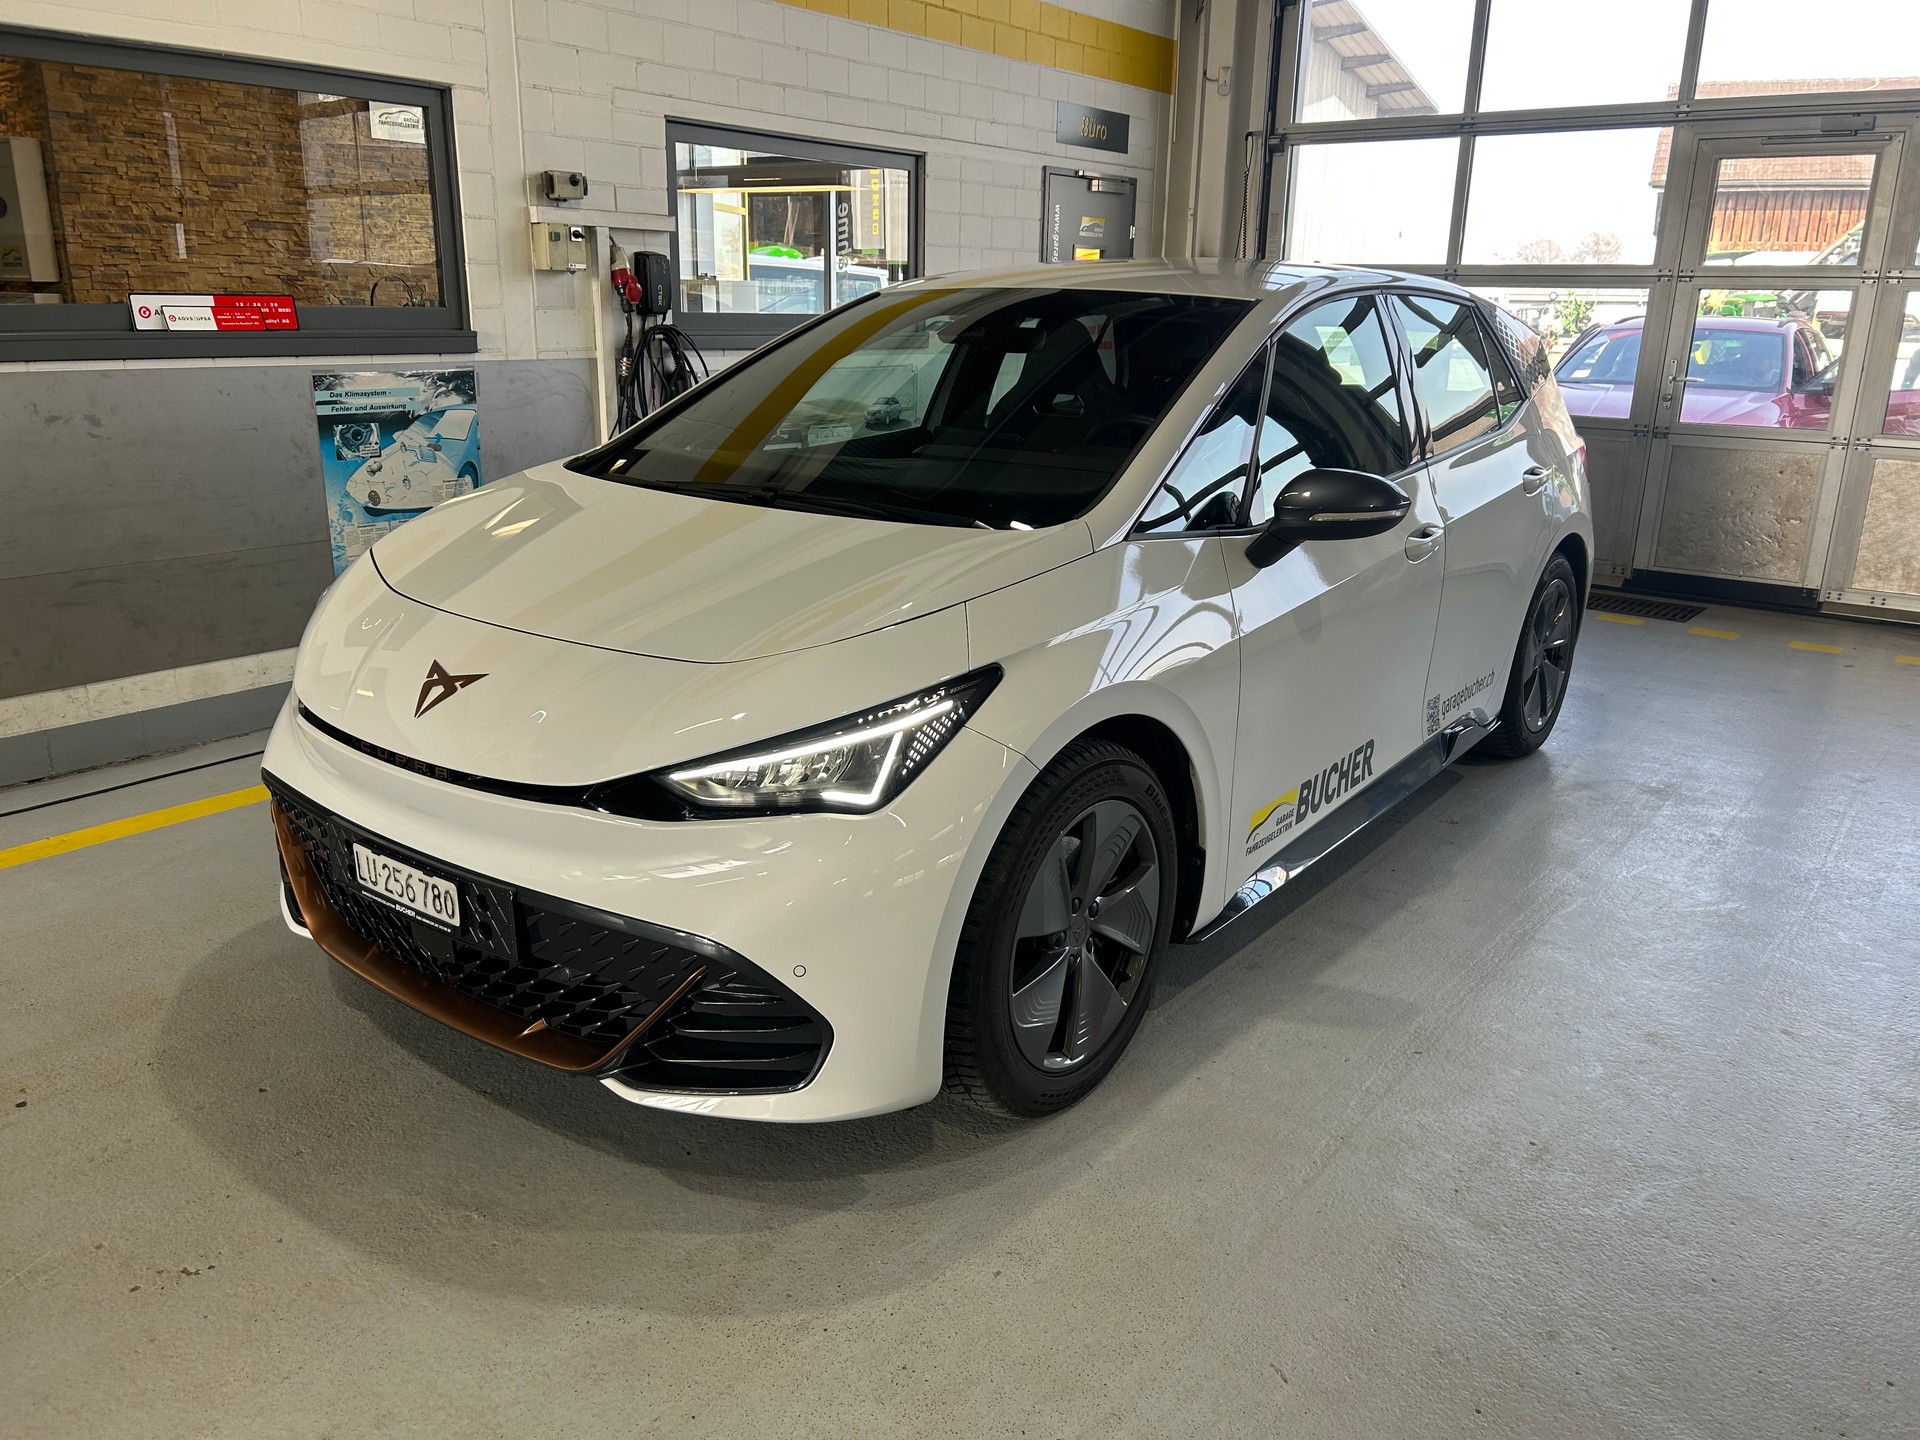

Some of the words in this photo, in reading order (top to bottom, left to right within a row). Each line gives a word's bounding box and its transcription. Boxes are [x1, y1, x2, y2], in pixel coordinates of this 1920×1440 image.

[1080, 115, 1108, 141] Büro
[1051, 204, 1061, 263] www.garag
[344, 390, 387, 399] Klimasystem
[368, 403, 407, 411] Auswirkung
[1441, 667, 1495, 721] garagebucher.ch
[360, 740, 449, 779] CUPRA
[1294, 738, 1375, 826] BUCHER
[1275, 807, 1296, 827] GARAGE
[1244, 819, 1293, 857] FAHRZEUGELEKTRIK
